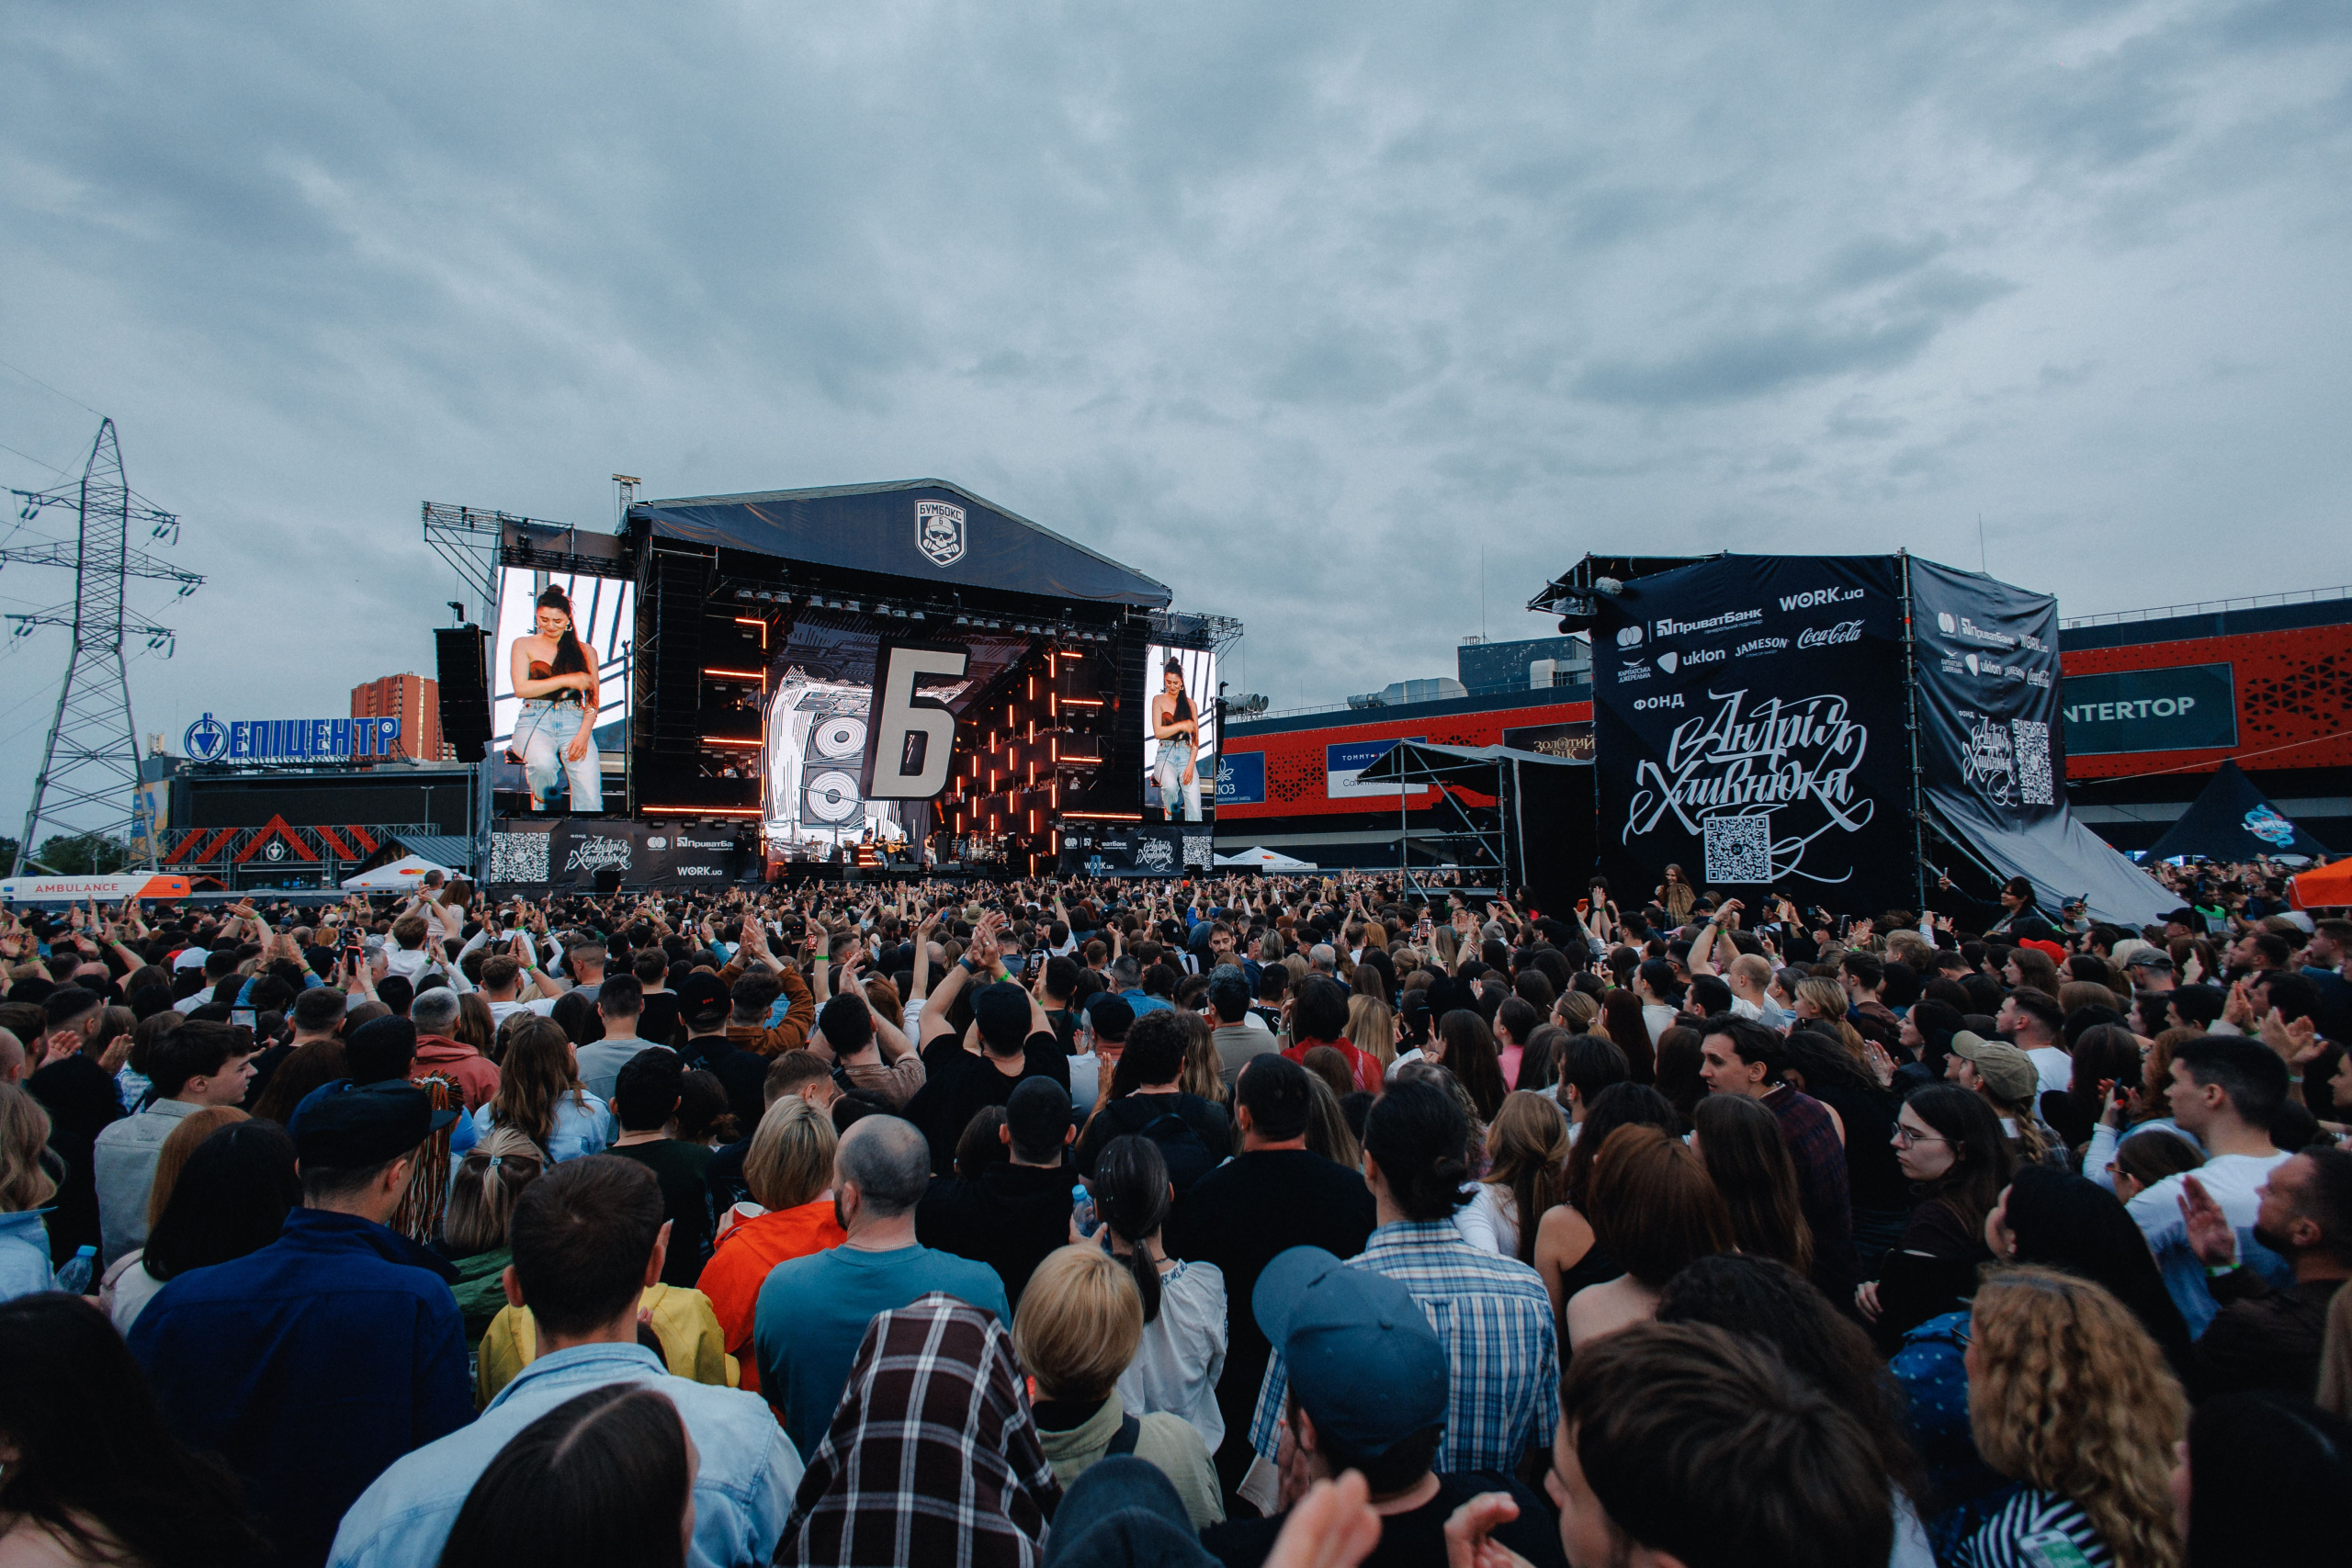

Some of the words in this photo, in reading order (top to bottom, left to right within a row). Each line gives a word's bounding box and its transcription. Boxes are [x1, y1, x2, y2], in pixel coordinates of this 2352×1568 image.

[920, 503, 962, 521] БУМБОКС
[1779, 586, 1864, 612] WORK.ua
[1673, 608, 1763, 635] ПриватБанк
[1797, 618, 1865, 649] Coca-Cola
[1969, 626, 2016, 646] ПриватБанк
[1735, 637, 1788, 657] JAMESON
[1682, 649, 1725, 666] uklon
[1617, 666, 1651, 678] КАРПАТСЬКА
[1980, 660, 2002, 676] uklon
[1618, 672, 1651, 683] ДЖЕРЕЛЬНА
[1634, 694, 1685, 710] ФОНД
[871, 647, 967, 797] Б
[230, 716, 401, 761] ЕПІЦЕНТР
[1342, 753, 1370, 761] TOMMY
[676, 866, 723, 876] WORK.ua
[35, 883, 119, 893] AMBULANCE
